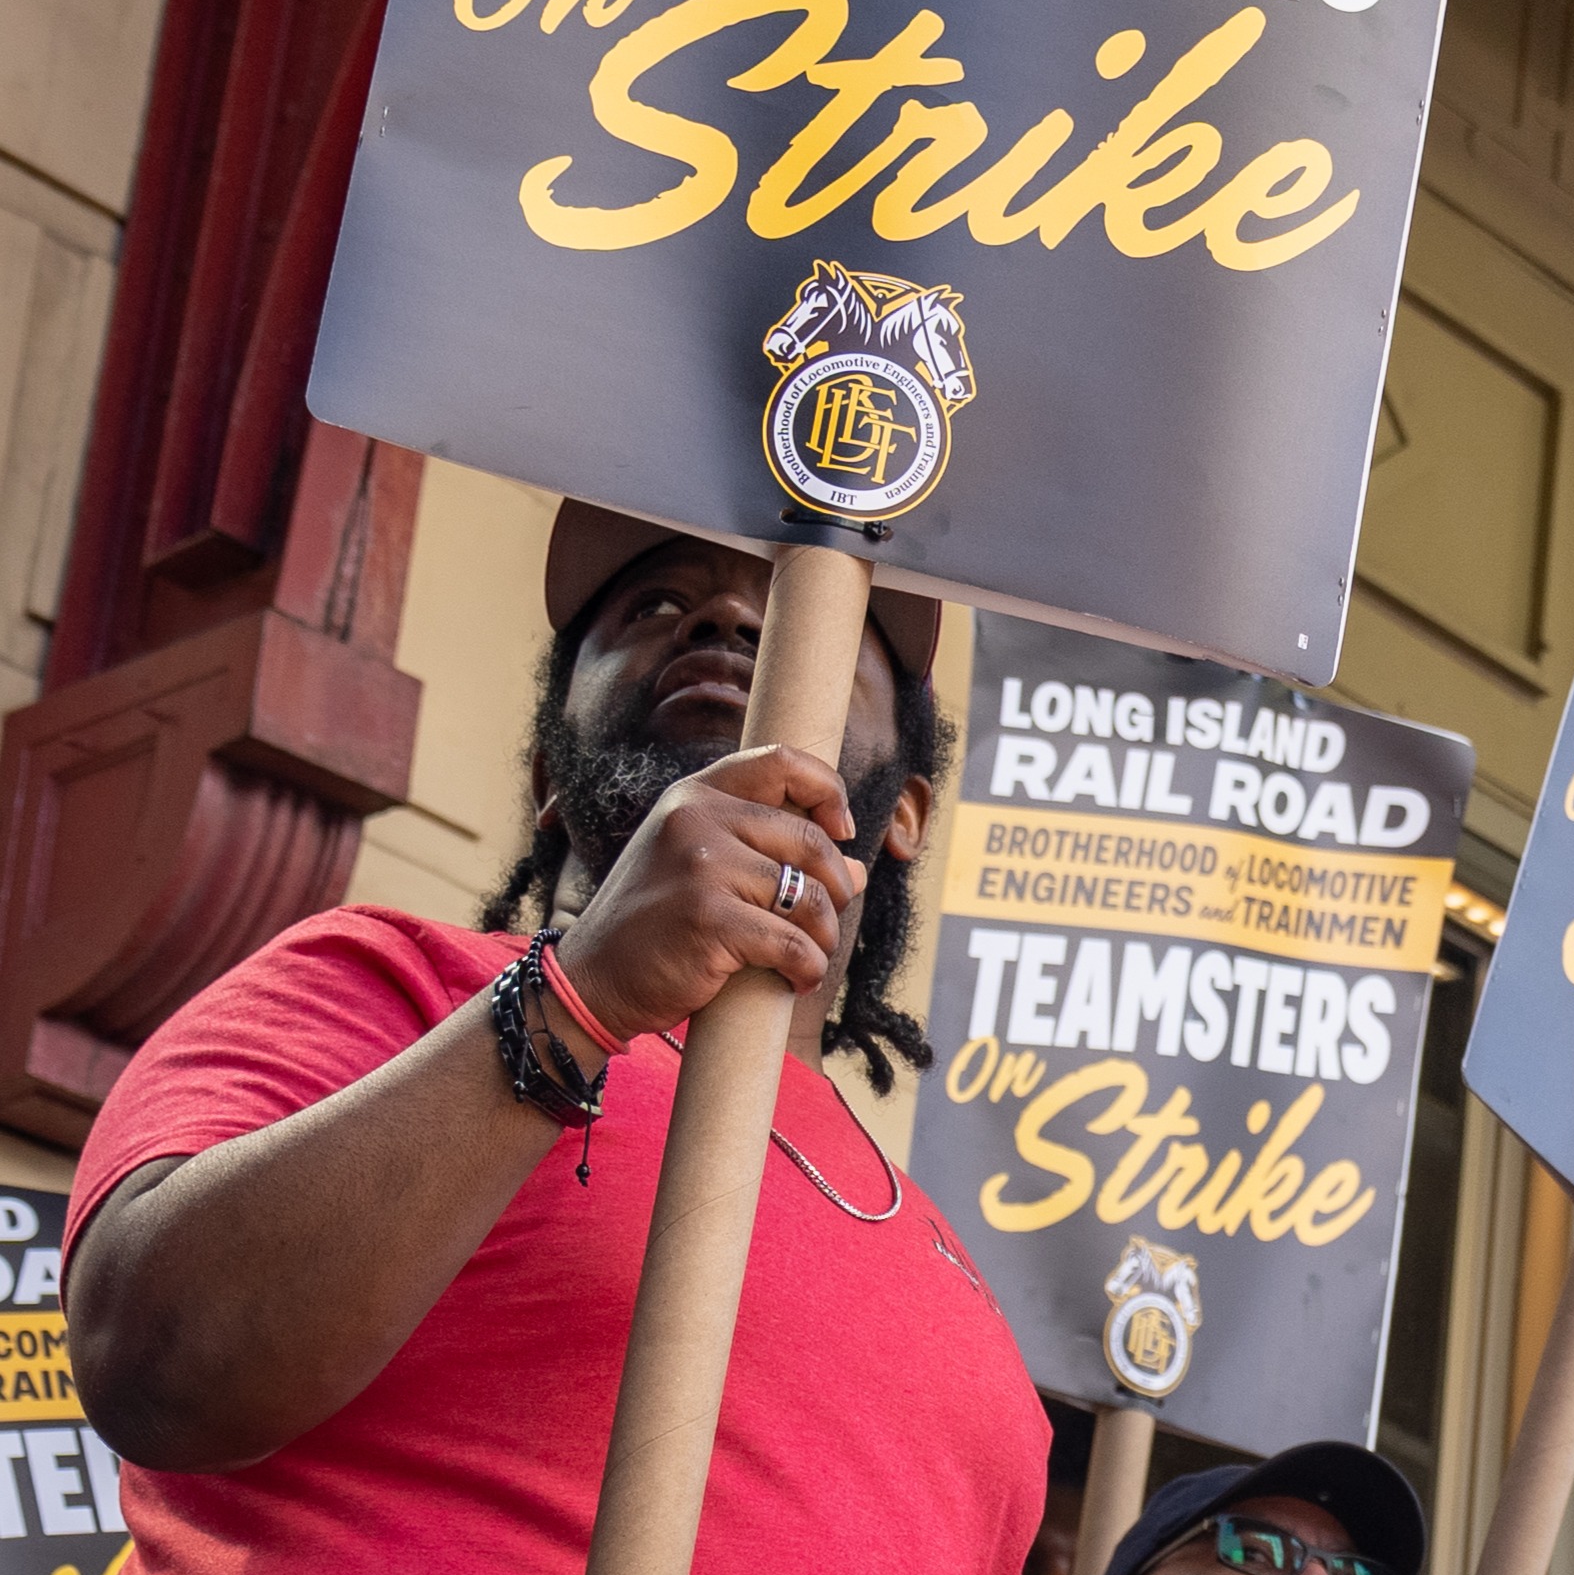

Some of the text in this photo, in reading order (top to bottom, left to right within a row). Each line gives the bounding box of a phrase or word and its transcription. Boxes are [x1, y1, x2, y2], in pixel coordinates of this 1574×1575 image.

[777, 356, 936, 500] Brotherhood of Locomotive Engineers and Trainmen
[830, 490, 857, 505] IBT
[1001, 677, 1346, 773] LONG ISLAND
[990, 735, 1431, 848] RAIL ROAD
[977, 867, 1194, 916] ENGINEERS
[1244, 897, 1407, 949] TRAINMEN
[985, 825, 1218, 876] BROTHERHOOD
[1247, 855, 1417, 907] LOCOMOTIVE
[968, 929, 1397, 1085] TEAMSTERS
[946, 1035, 1047, 1104] On
[979, 1058, 1377, 1248] Strike
